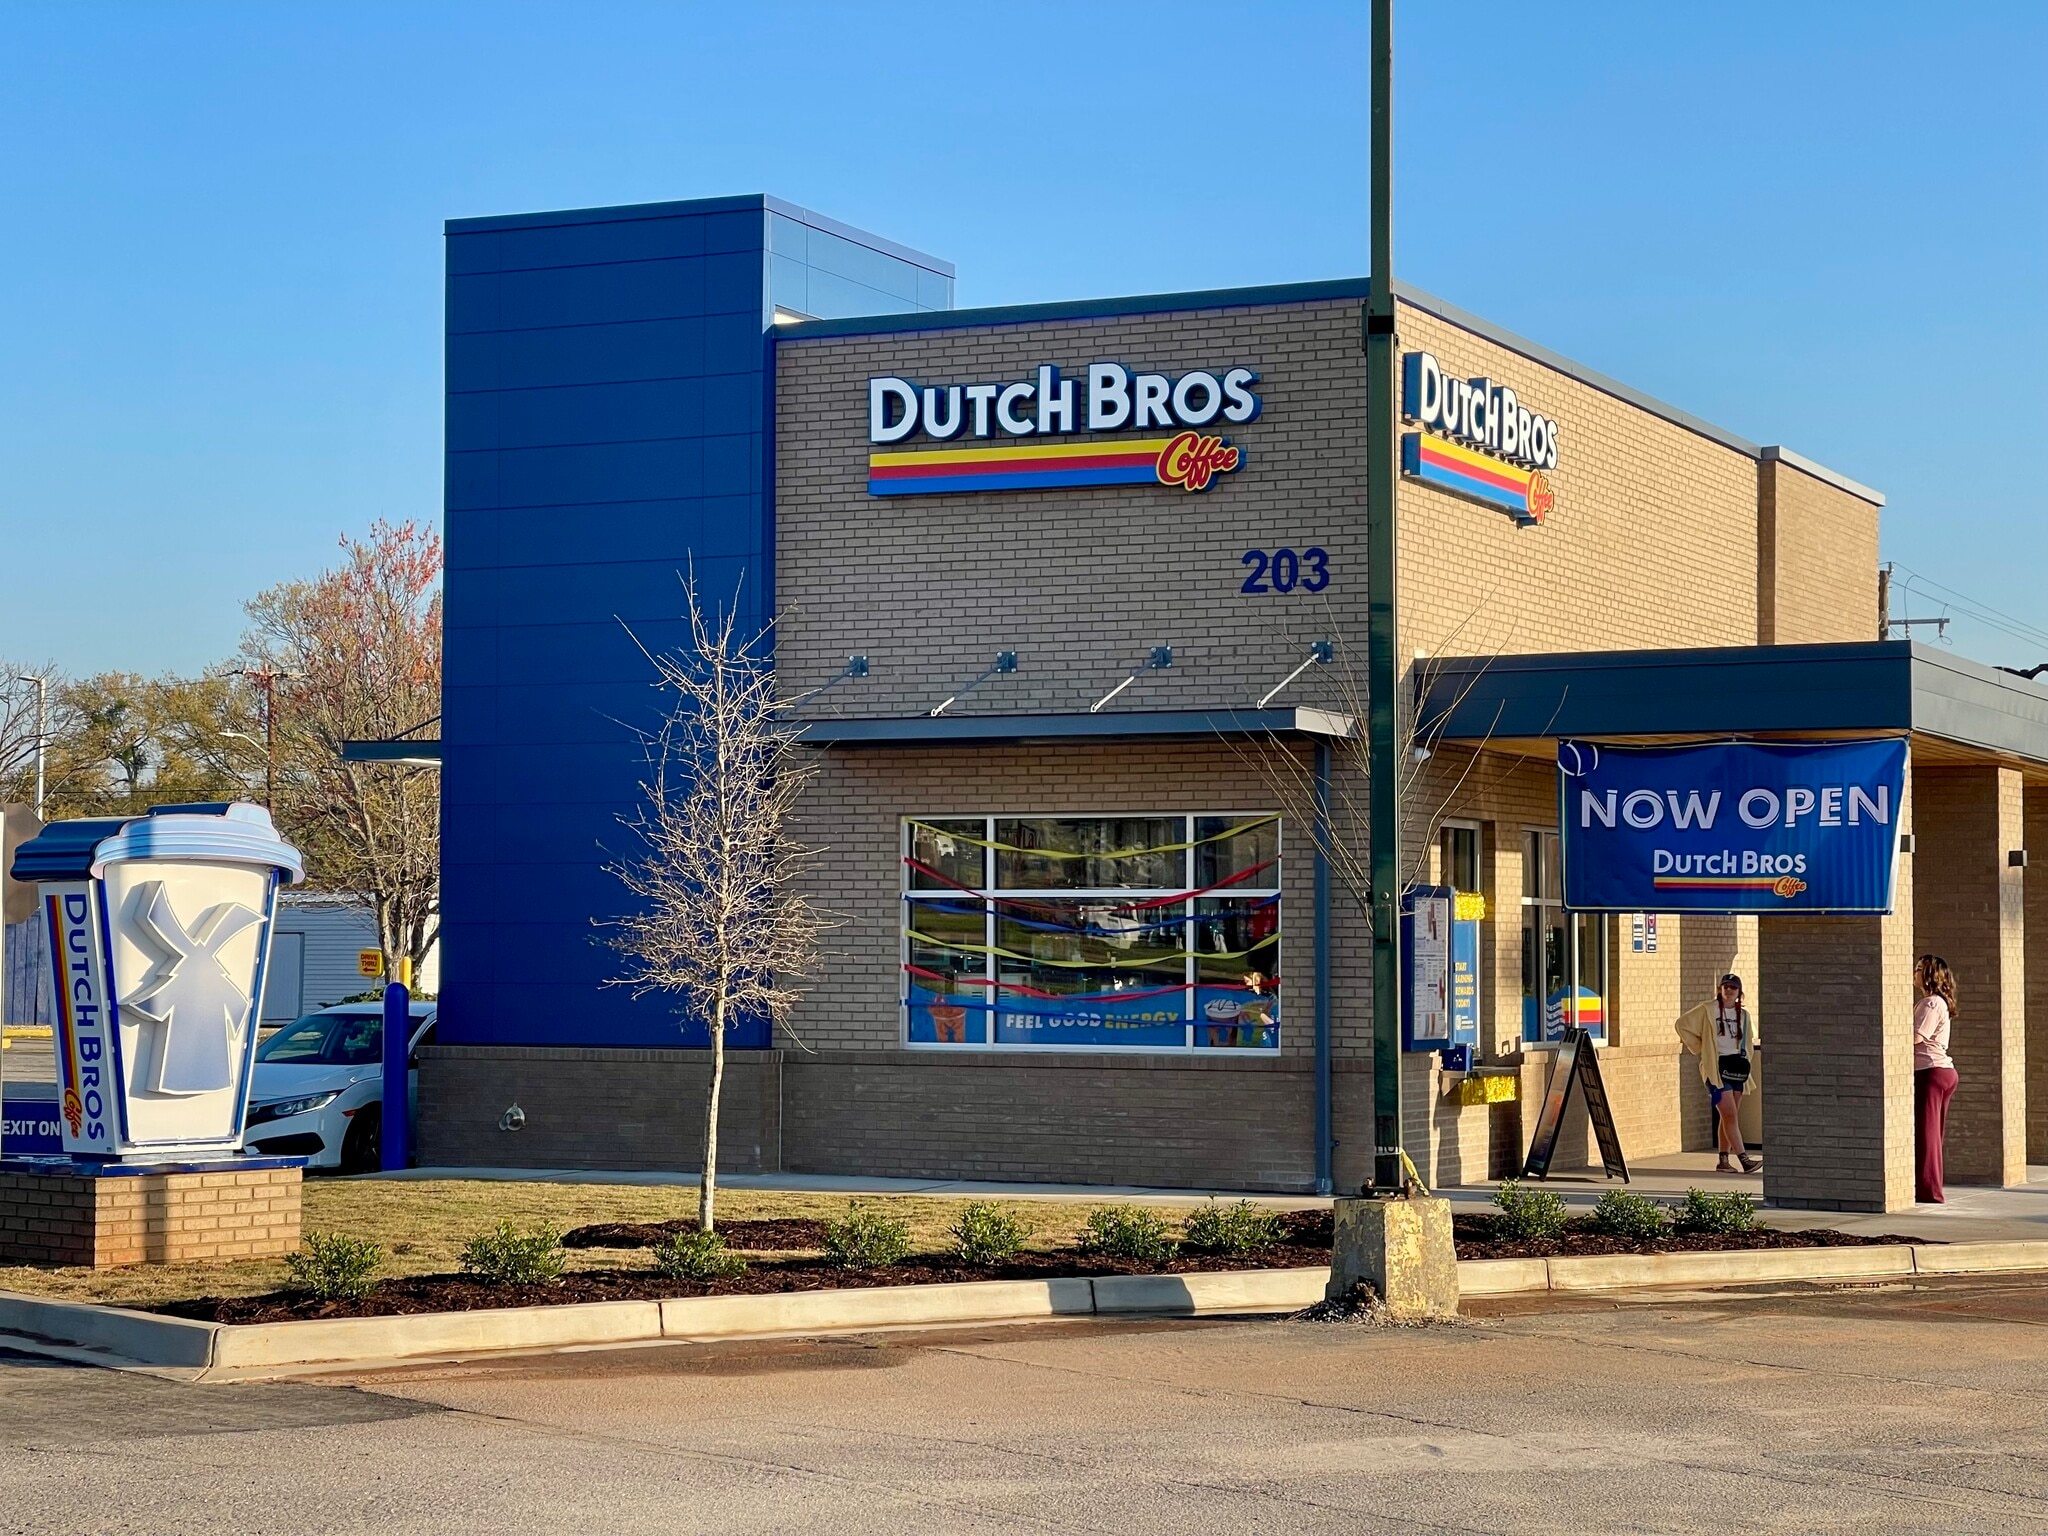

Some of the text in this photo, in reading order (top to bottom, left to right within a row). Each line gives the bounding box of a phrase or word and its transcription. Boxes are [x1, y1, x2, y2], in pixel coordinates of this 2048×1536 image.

[869, 362, 1259, 443] DUTCH BROS
[1420, 352, 1558, 470] DUTCH BROS
[1157, 432, 1241, 491] Coffee
[1241, 547, 1330, 594] 203
[1581, 784, 1889, 830] NOW OPEN
[1653, 849, 1806, 874] DUTCH BROS
[1773, 875, 1808, 898] Coffee
[360, 953, 378, 961] DRIVE
[64, 893, 105, 1141] DUTCH BROS
[1005, 1013, 1044, 1029] FEEL
[1048, 1012, 1101, 1028] GOOD
[1, 1120, 36, 1136] EXIT
[63, 1087, 82, 1139] Coffee
